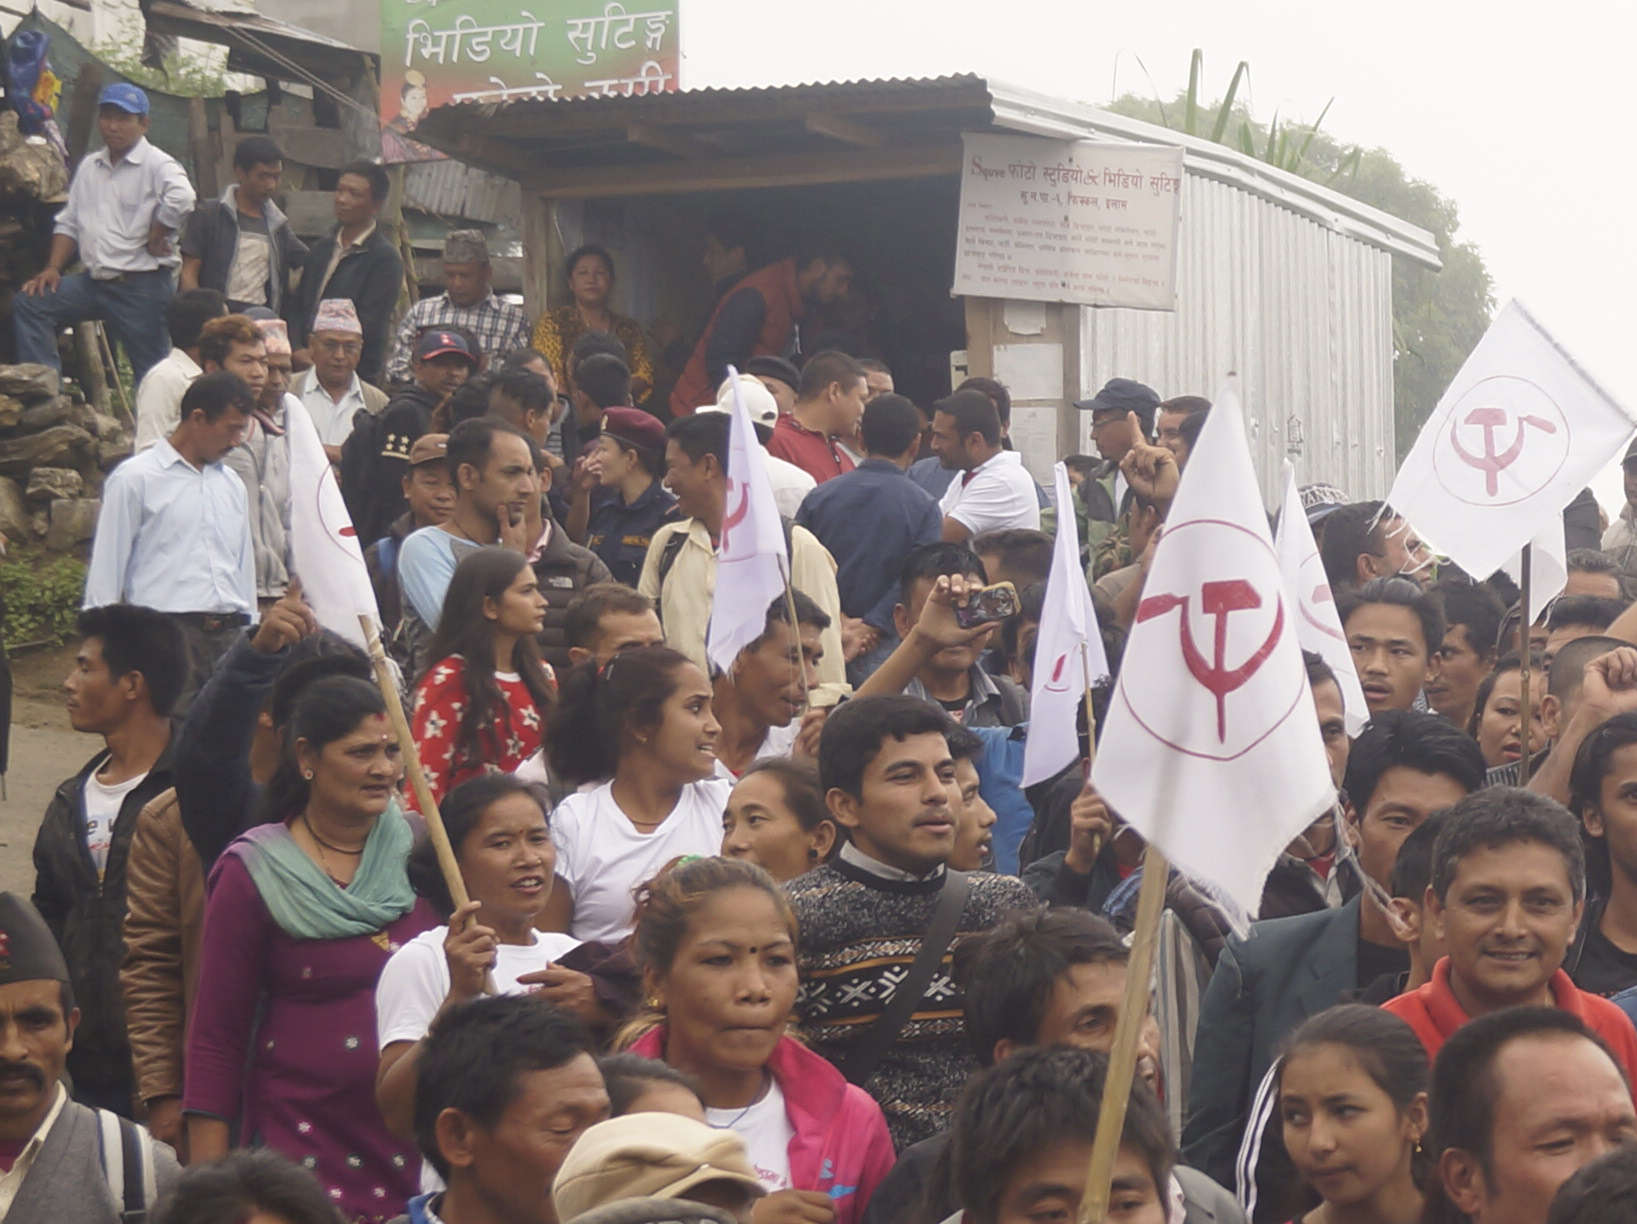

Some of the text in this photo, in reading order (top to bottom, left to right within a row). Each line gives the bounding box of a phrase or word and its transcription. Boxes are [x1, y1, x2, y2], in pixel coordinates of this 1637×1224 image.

[405, 11, 545, 67] भिडियो
[1007, 159, 1037, 180] फोटो
[1103, 166, 1143, 190] भिडियो
